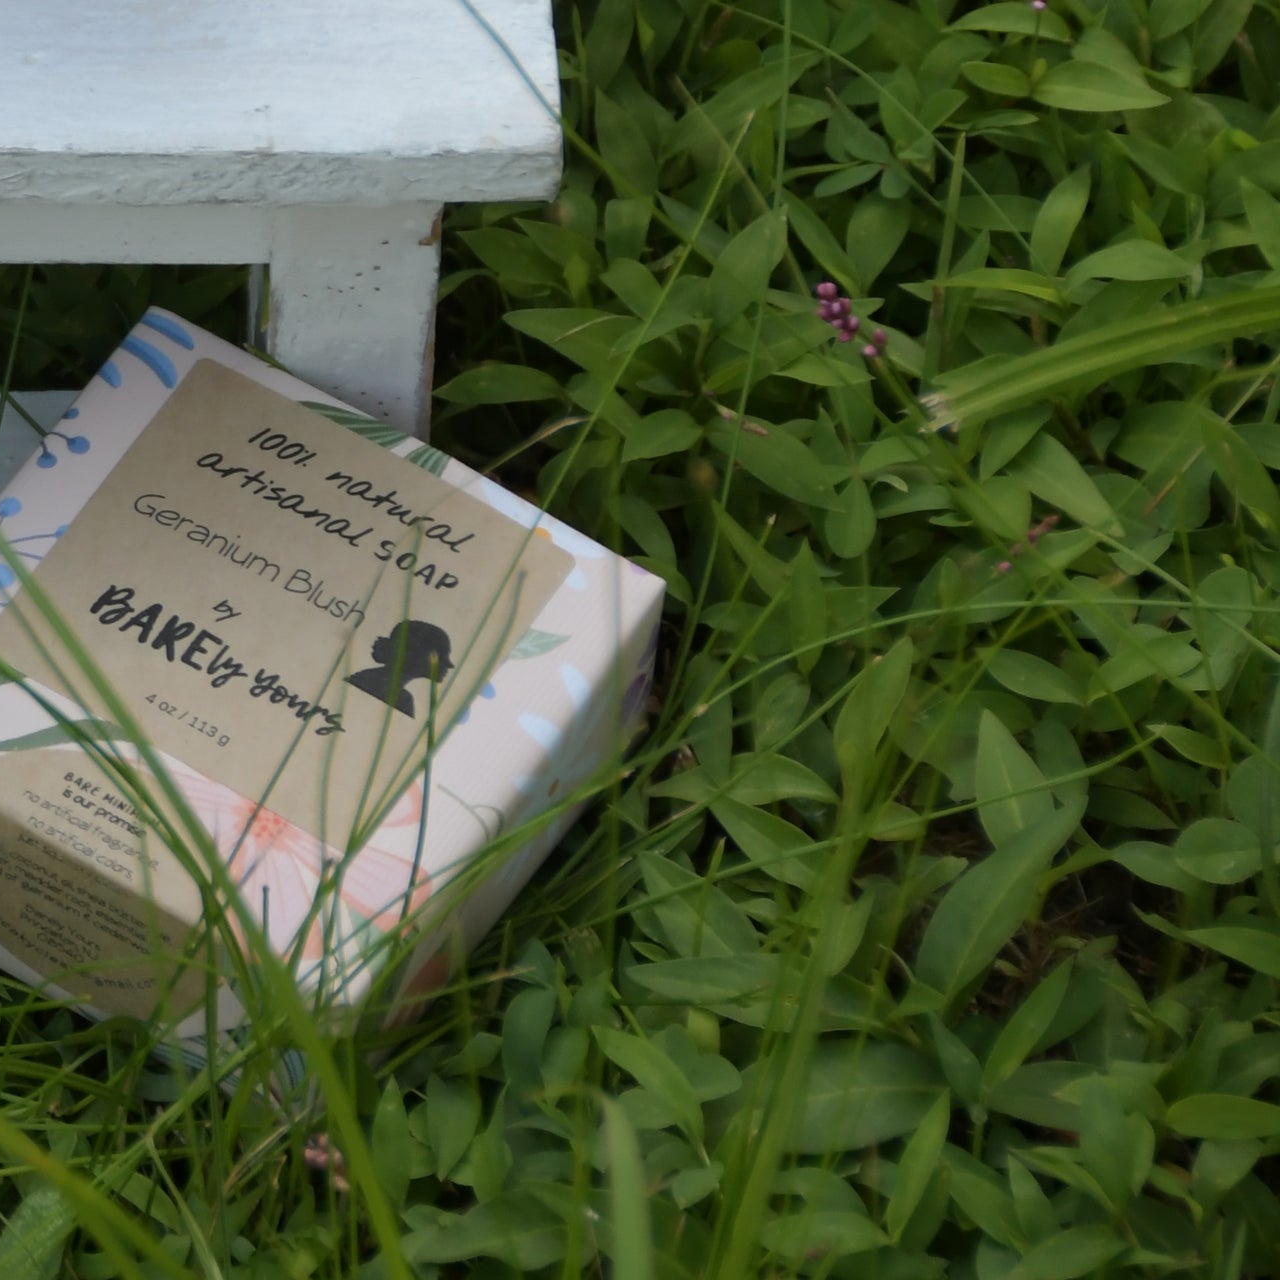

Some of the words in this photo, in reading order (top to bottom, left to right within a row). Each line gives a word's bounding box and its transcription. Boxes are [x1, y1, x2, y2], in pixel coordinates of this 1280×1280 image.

[247, 427, 317, 468] 100%
[324, 471, 475, 553] natural
[195, 452, 374, 547] artisanal
[373, 539, 459, 590] SOAP
[133, 493, 281, 582] Geranium
[283, 568, 370, 630] Blush
[211, 599, 242, 623] by
[144, 693, 158, 704] 4
[157, 701, 178, 716] oz
[176, 710, 190, 721] /
[187, 716, 219, 738] 113
[216, 734, 231, 748] g
[62, 787, 73, 799] is
[72, 795, 97, 810] our
[63, 771, 100, 796] BARE
[23, 789, 41, 804] no
[39, 800, 96, 832] artificial
[26, 815, 45, 831] no
[41, 825, 97, 858] artificial
